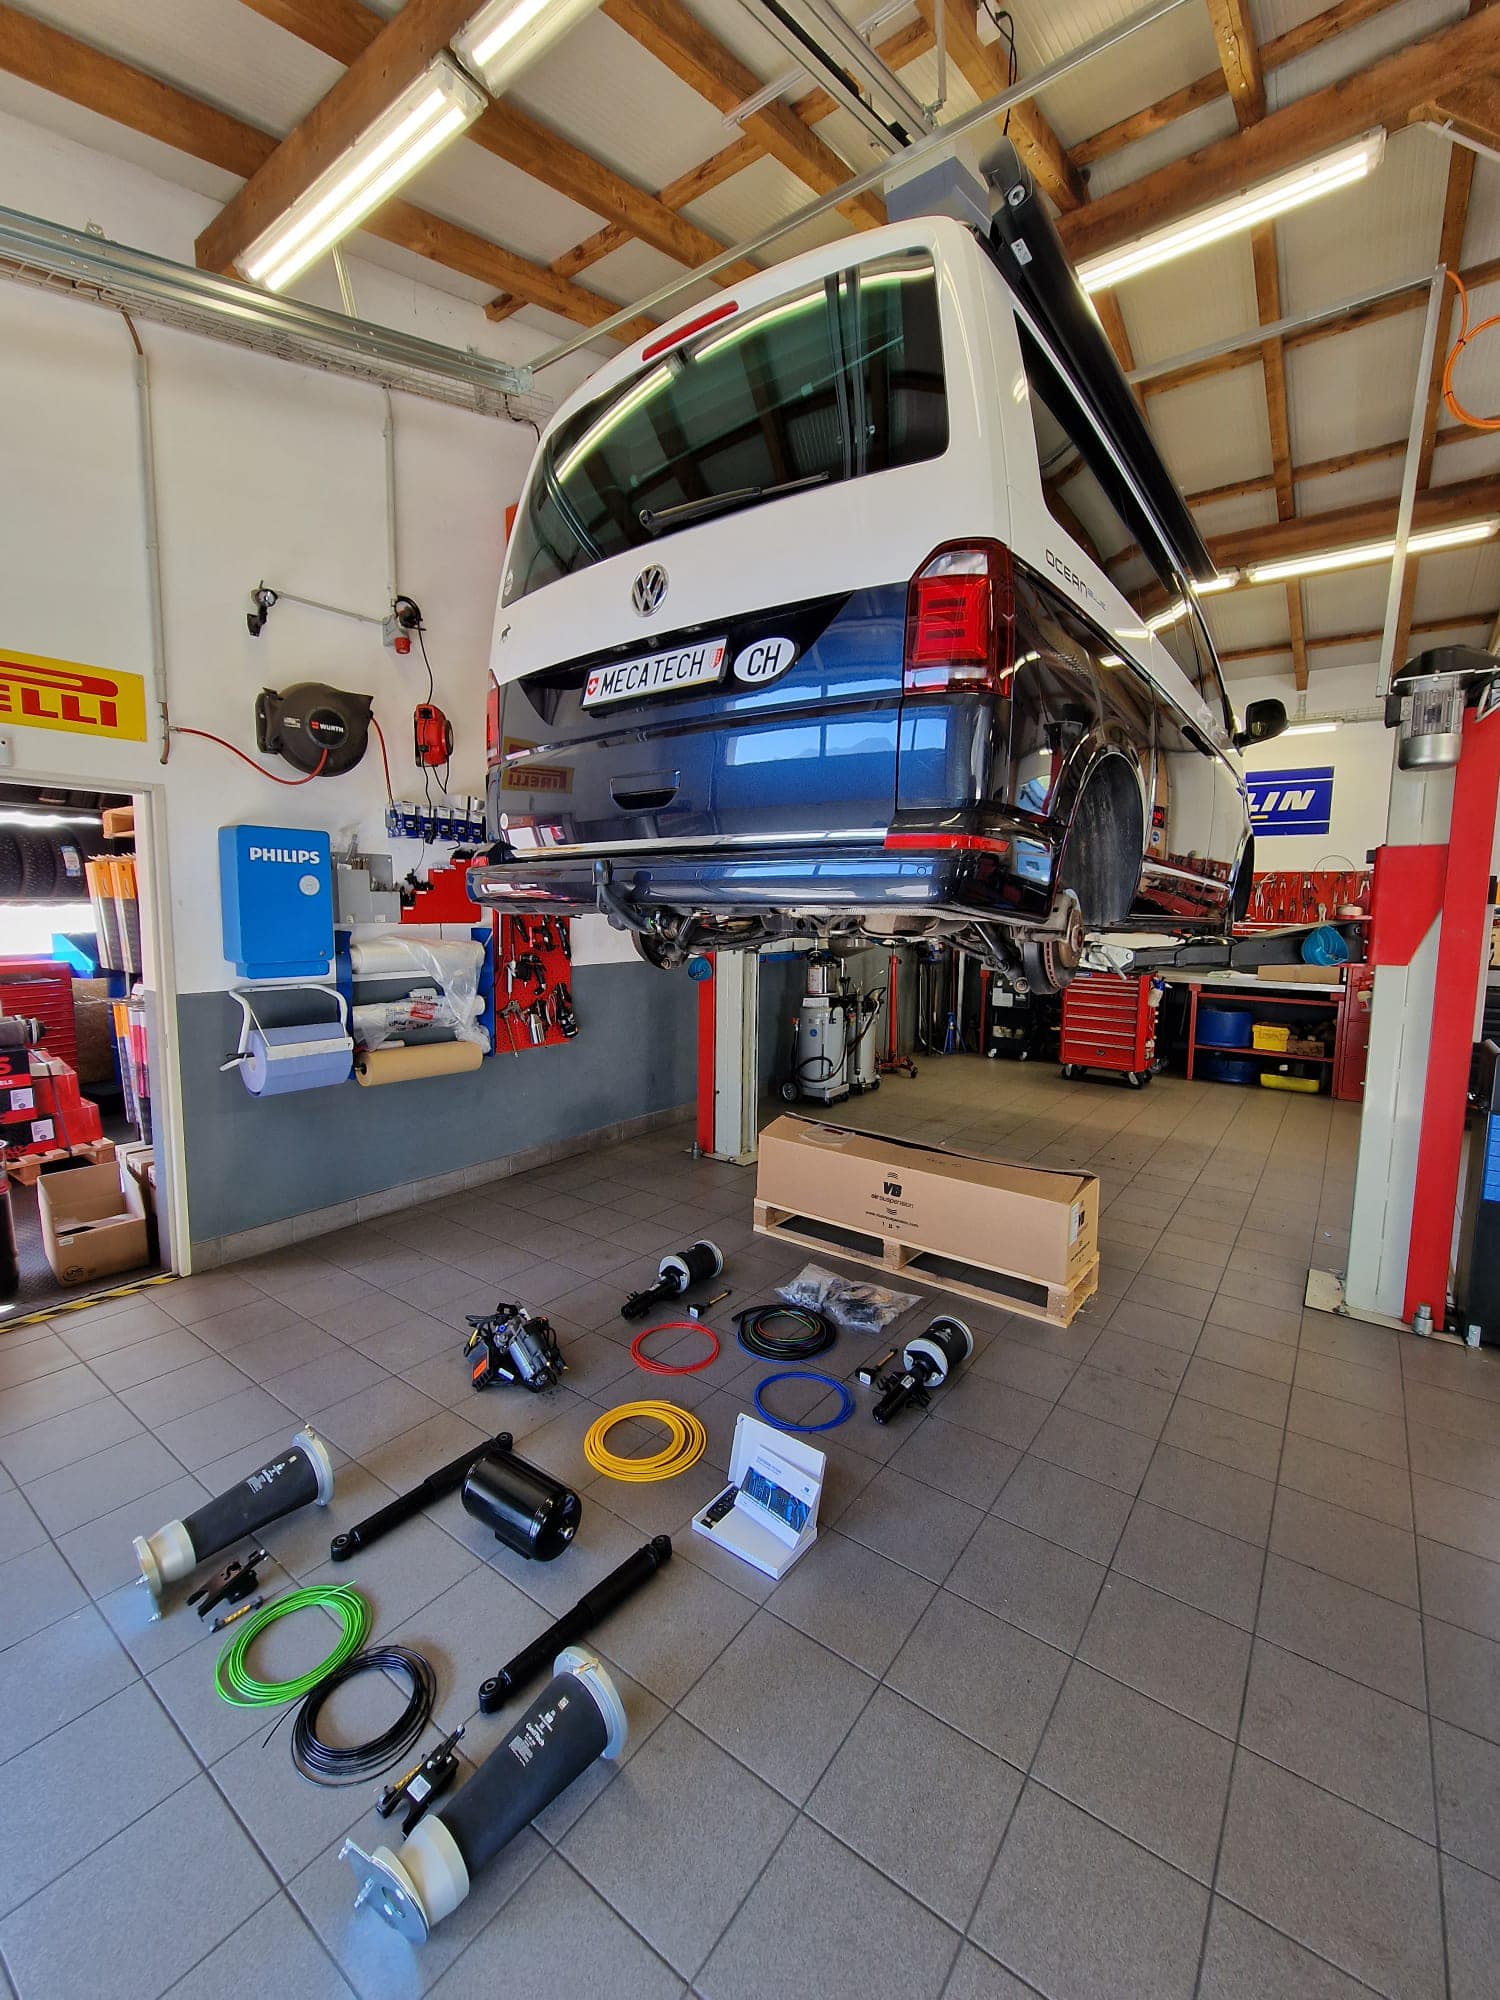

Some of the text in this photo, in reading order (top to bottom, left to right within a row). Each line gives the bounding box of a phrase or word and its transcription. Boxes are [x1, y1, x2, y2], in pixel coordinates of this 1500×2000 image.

[599, 649, 706, 697] MECATECH
[746, 643, 782, 677] CH
[249, 846, 320, 865] PHILIPS
[883, 1181, 902, 1198] VB
